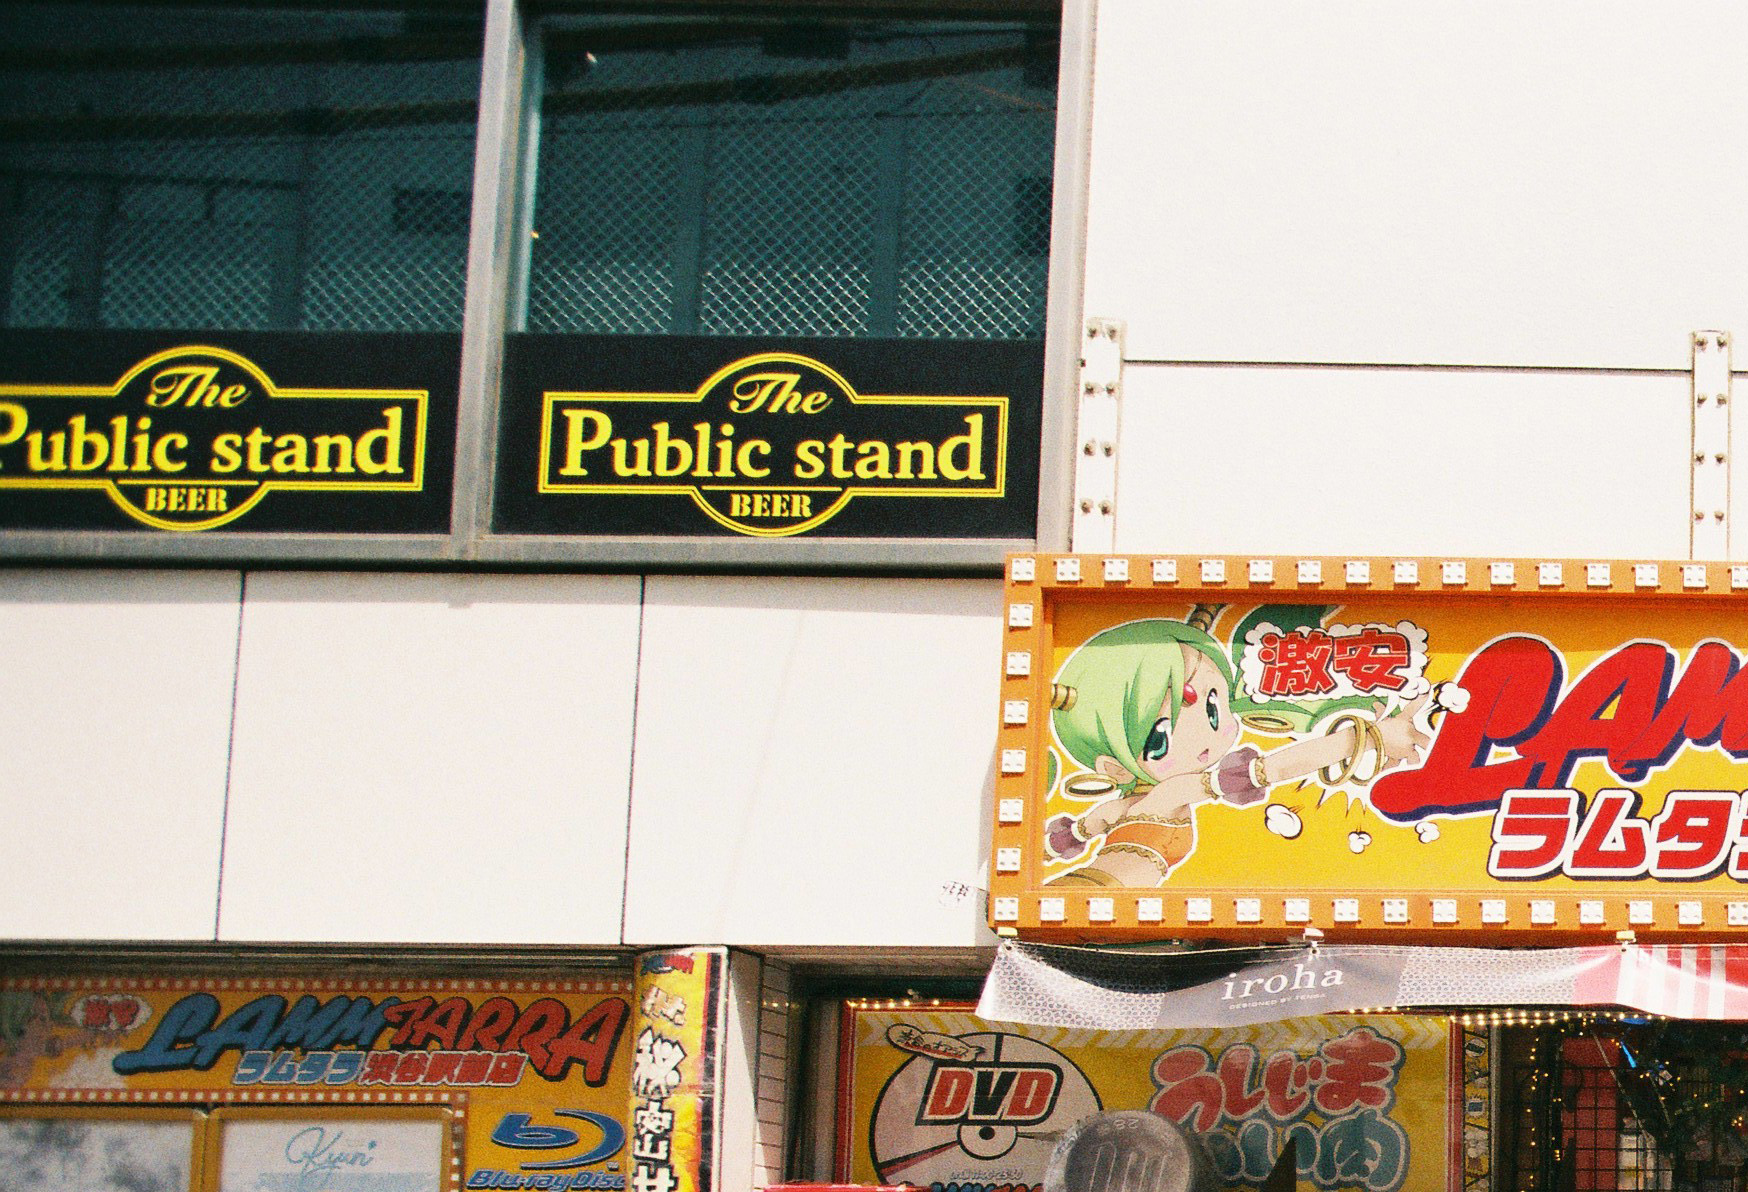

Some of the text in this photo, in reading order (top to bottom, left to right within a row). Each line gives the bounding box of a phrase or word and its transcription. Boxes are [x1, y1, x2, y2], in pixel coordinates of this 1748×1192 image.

[147, 365, 251, 411] The
[729, 370, 833, 415] The
[211, 408, 404, 476] stand
[559, 411, 986, 481] Public stand
[145, 488, 227, 513] BEER
[730, 493, 812, 518] BEER
[1259, 627, 1411, 694] 激安
[1221, 964, 1344, 1000] iroha
[919, 1065, 1060, 1123] DVD
[1152, 1028, 1404, 1130] うしじま
[573, 1169, 625, 1191] Disc
